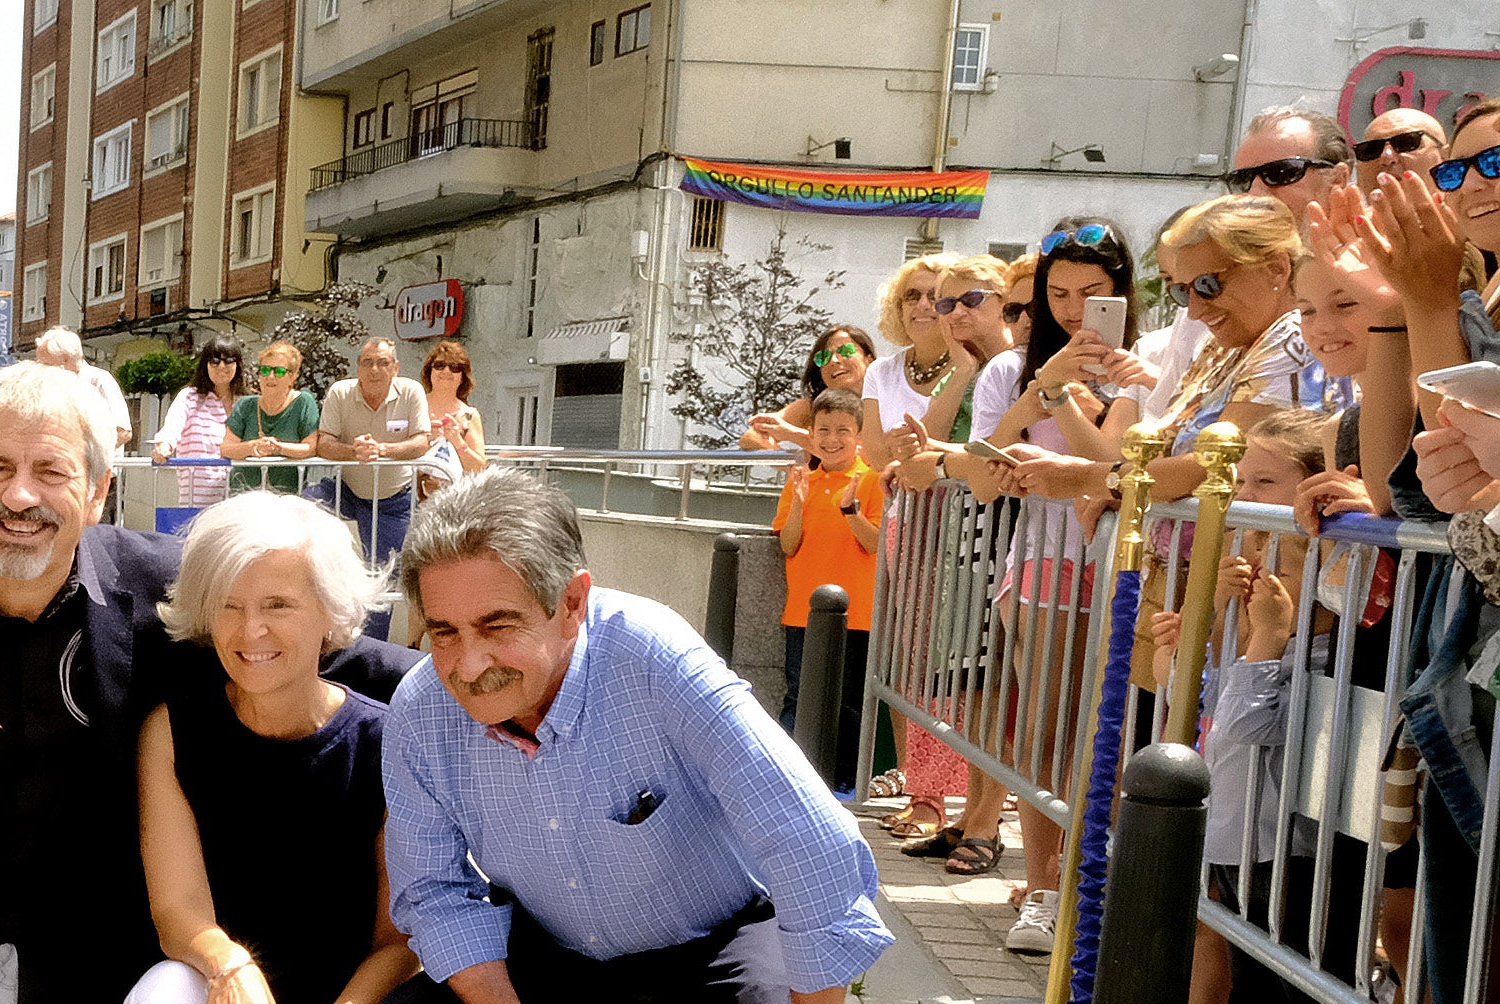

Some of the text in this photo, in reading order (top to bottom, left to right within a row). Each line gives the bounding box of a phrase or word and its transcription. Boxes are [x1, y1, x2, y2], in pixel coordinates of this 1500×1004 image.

[708, 169, 958, 205] ORGULLO SANTANDER
[398, 295, 456, 329] dragon
